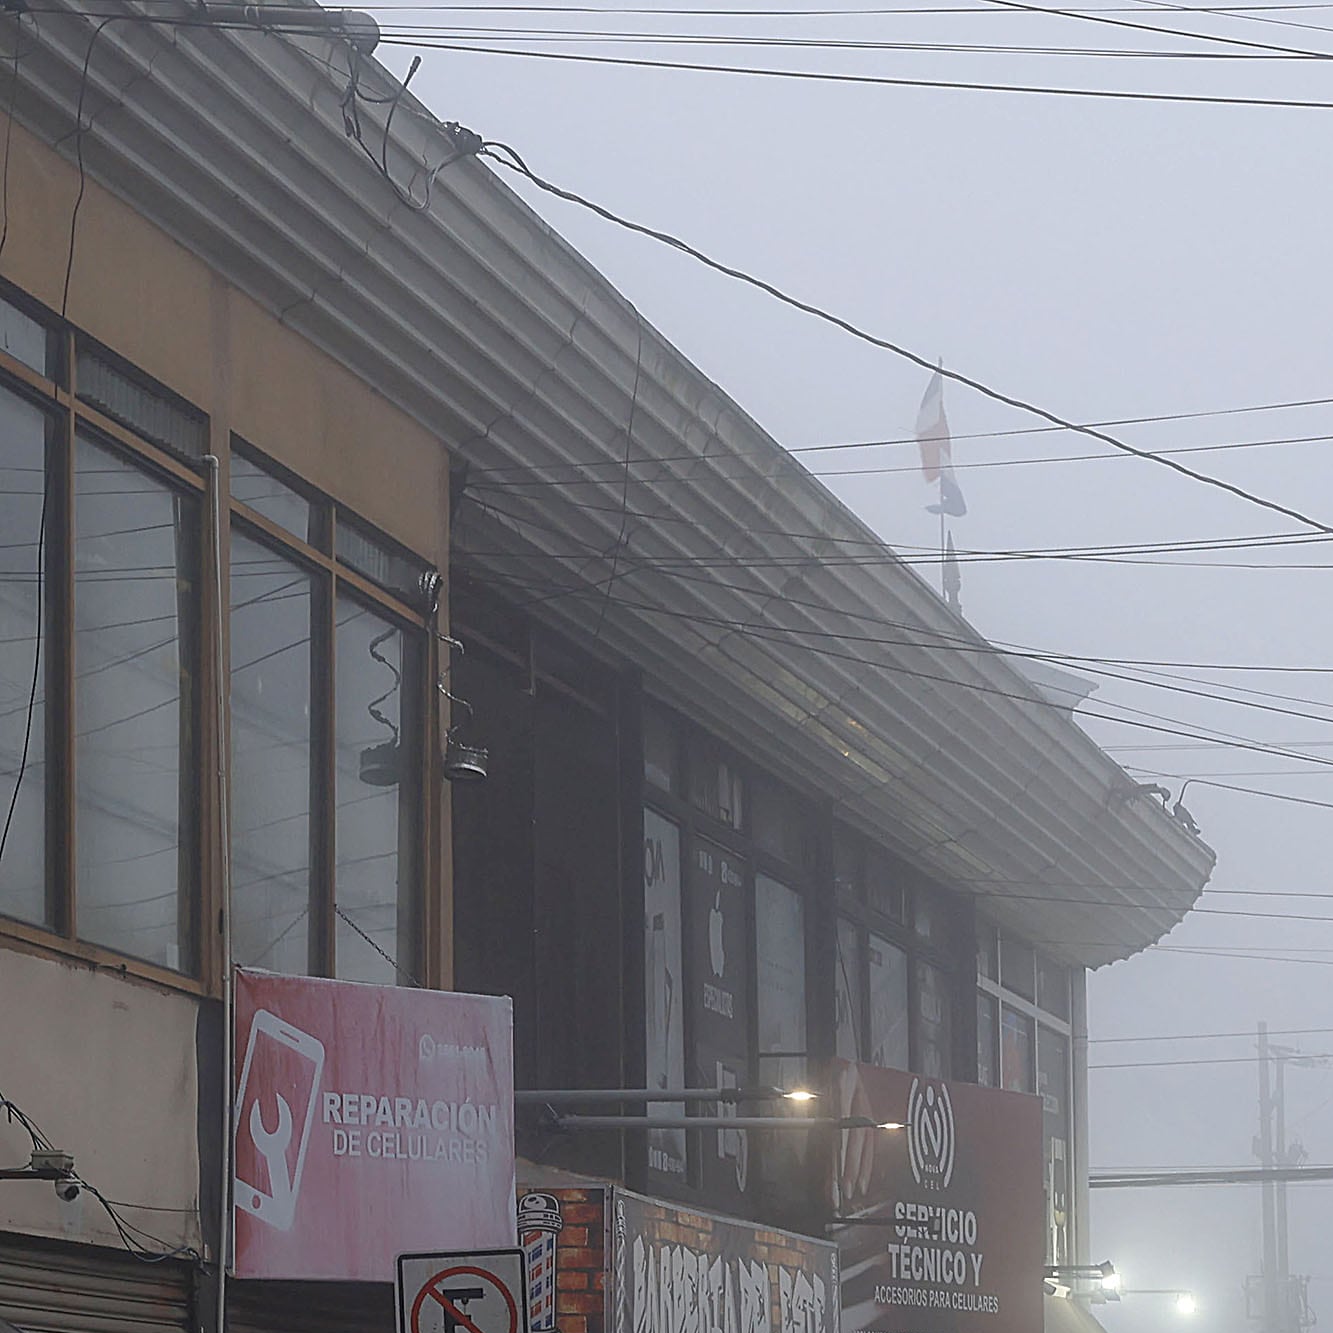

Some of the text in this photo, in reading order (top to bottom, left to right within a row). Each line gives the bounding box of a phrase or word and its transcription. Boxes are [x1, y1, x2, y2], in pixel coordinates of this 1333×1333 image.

[322, 1092, 497, 1135] REPARACIÓN
[333, 1128, 489, 1164] DE CELULARES
[888, 1237, 984, 1287] TÉCNICO Y
[874, 1285, 999, 1315] ACCESORIOS PARA CELULARES
